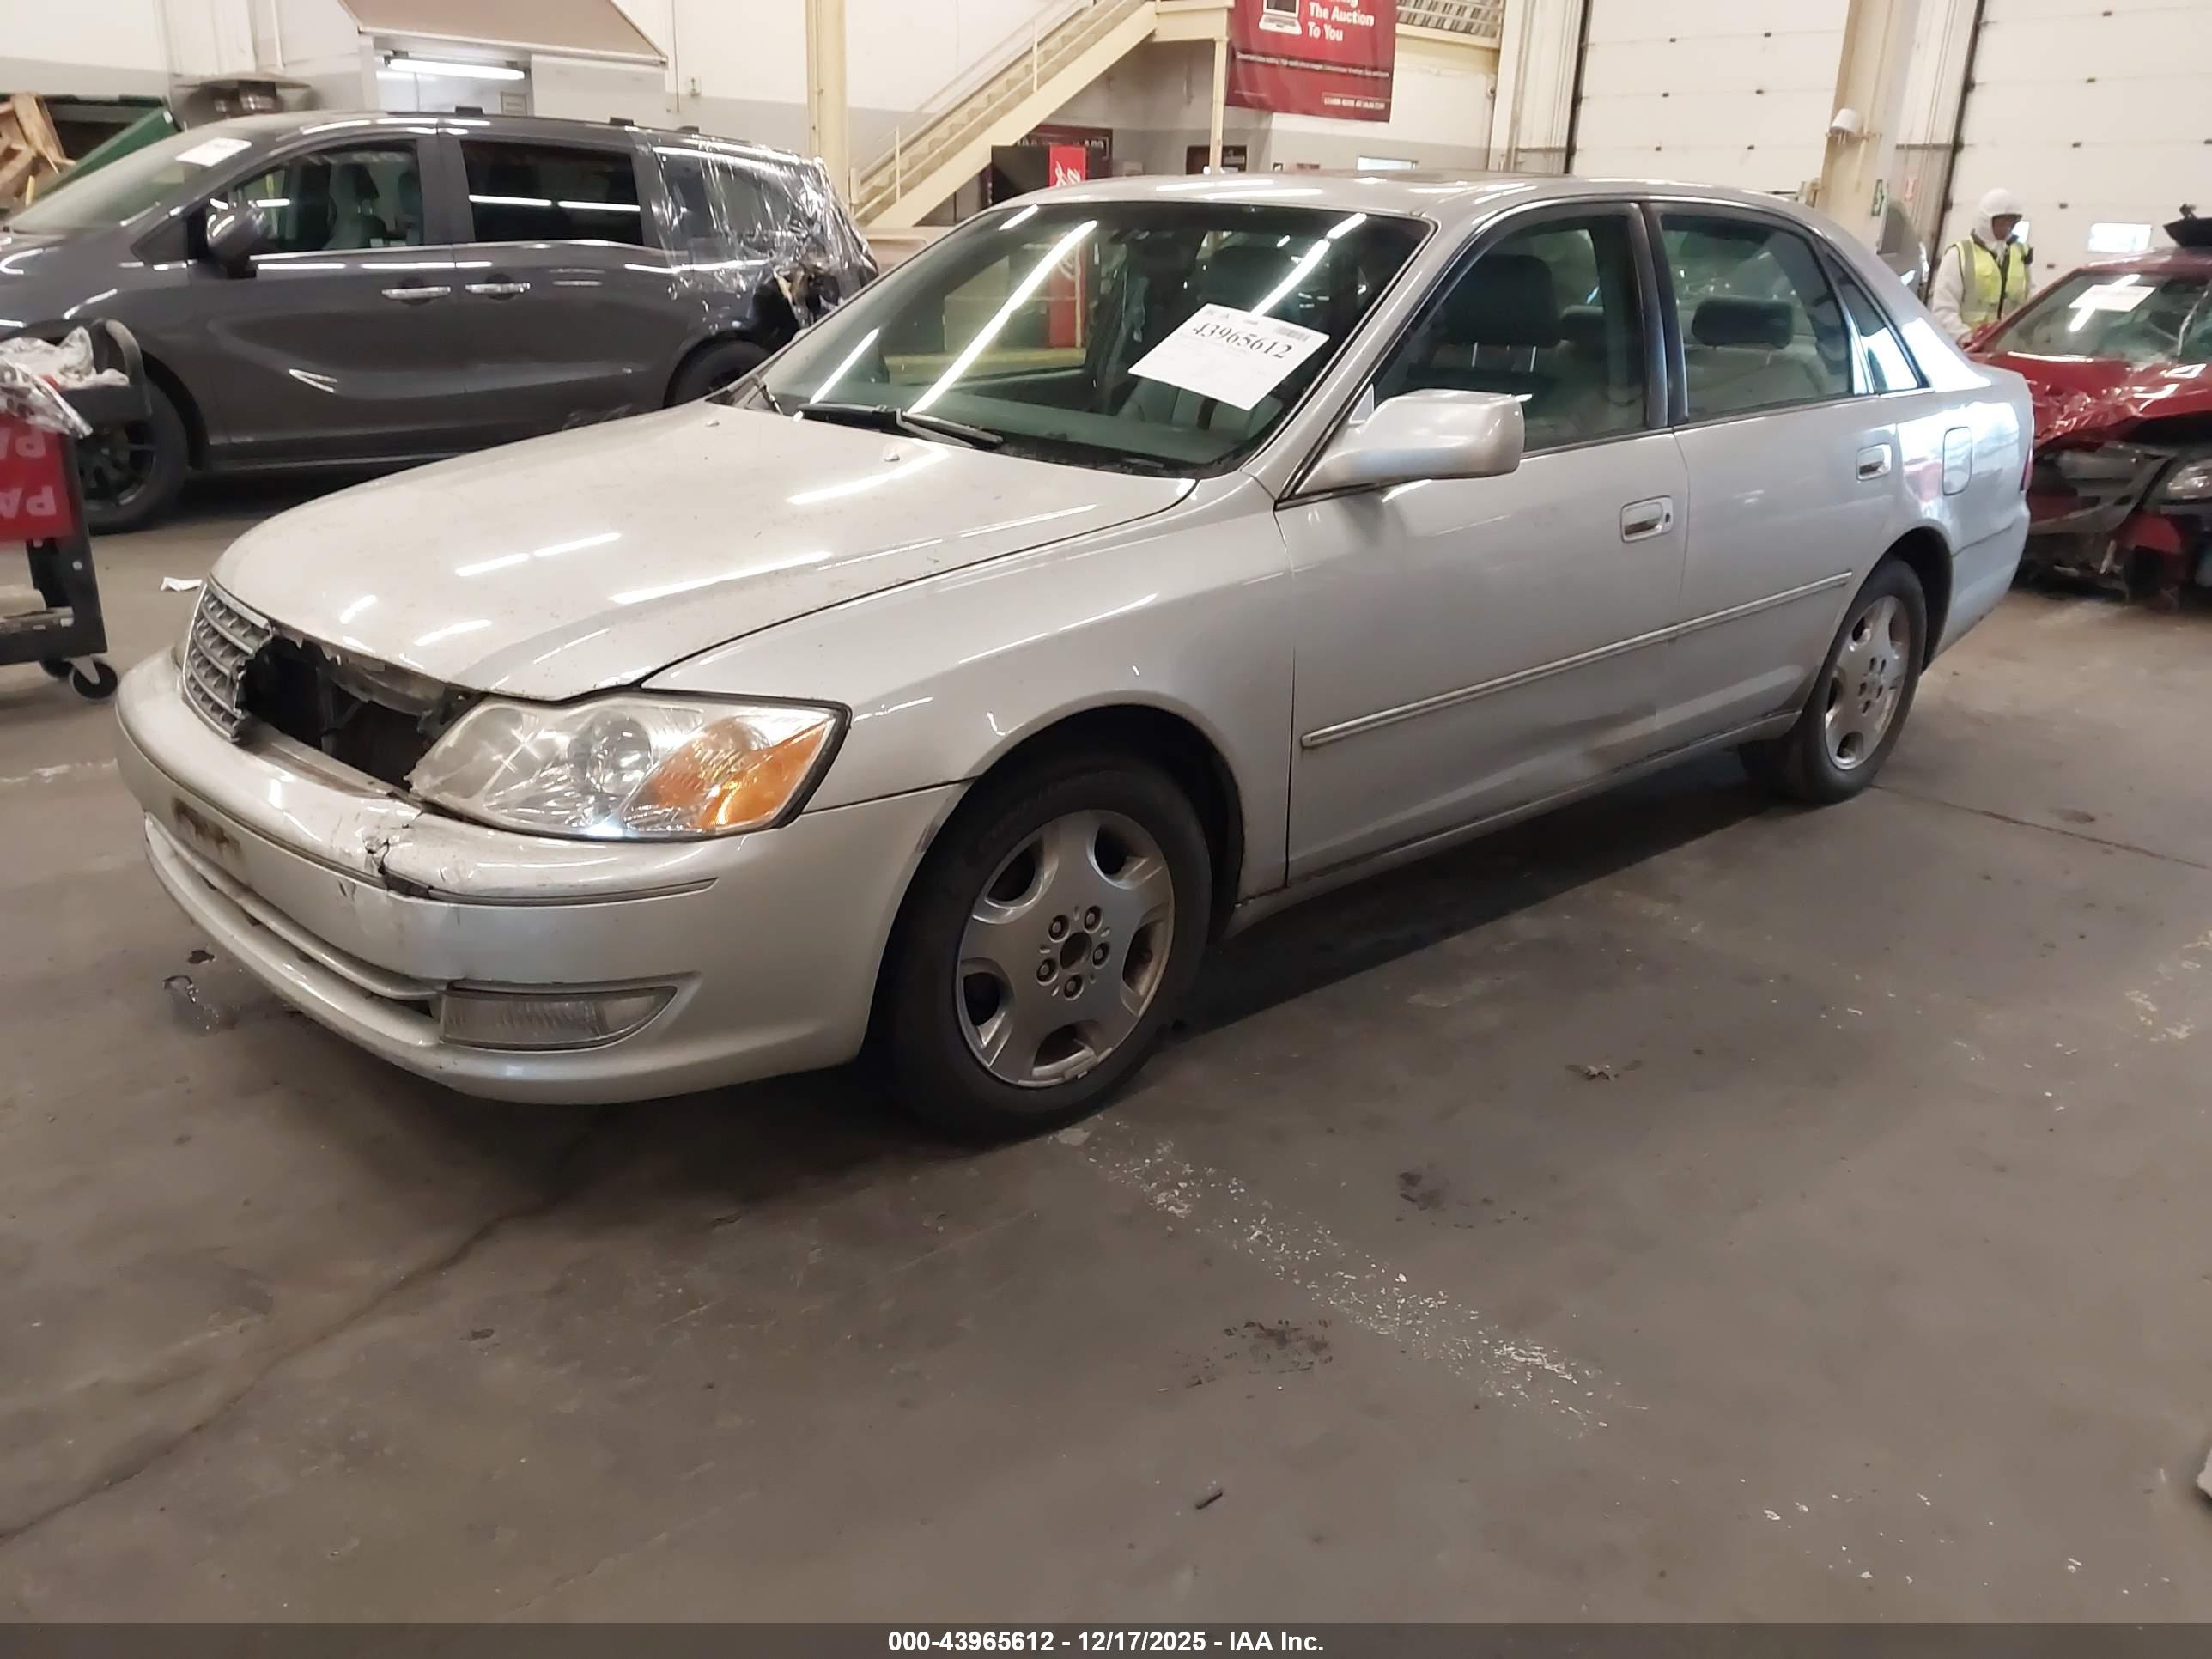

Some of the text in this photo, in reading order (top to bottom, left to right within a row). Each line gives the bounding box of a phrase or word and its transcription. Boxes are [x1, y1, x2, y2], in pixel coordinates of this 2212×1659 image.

[1309, 2, 1375, 27] The Auction
[1308, 21, 1343, 41] To You
[1193, 323, 1292, 358] 43965612
